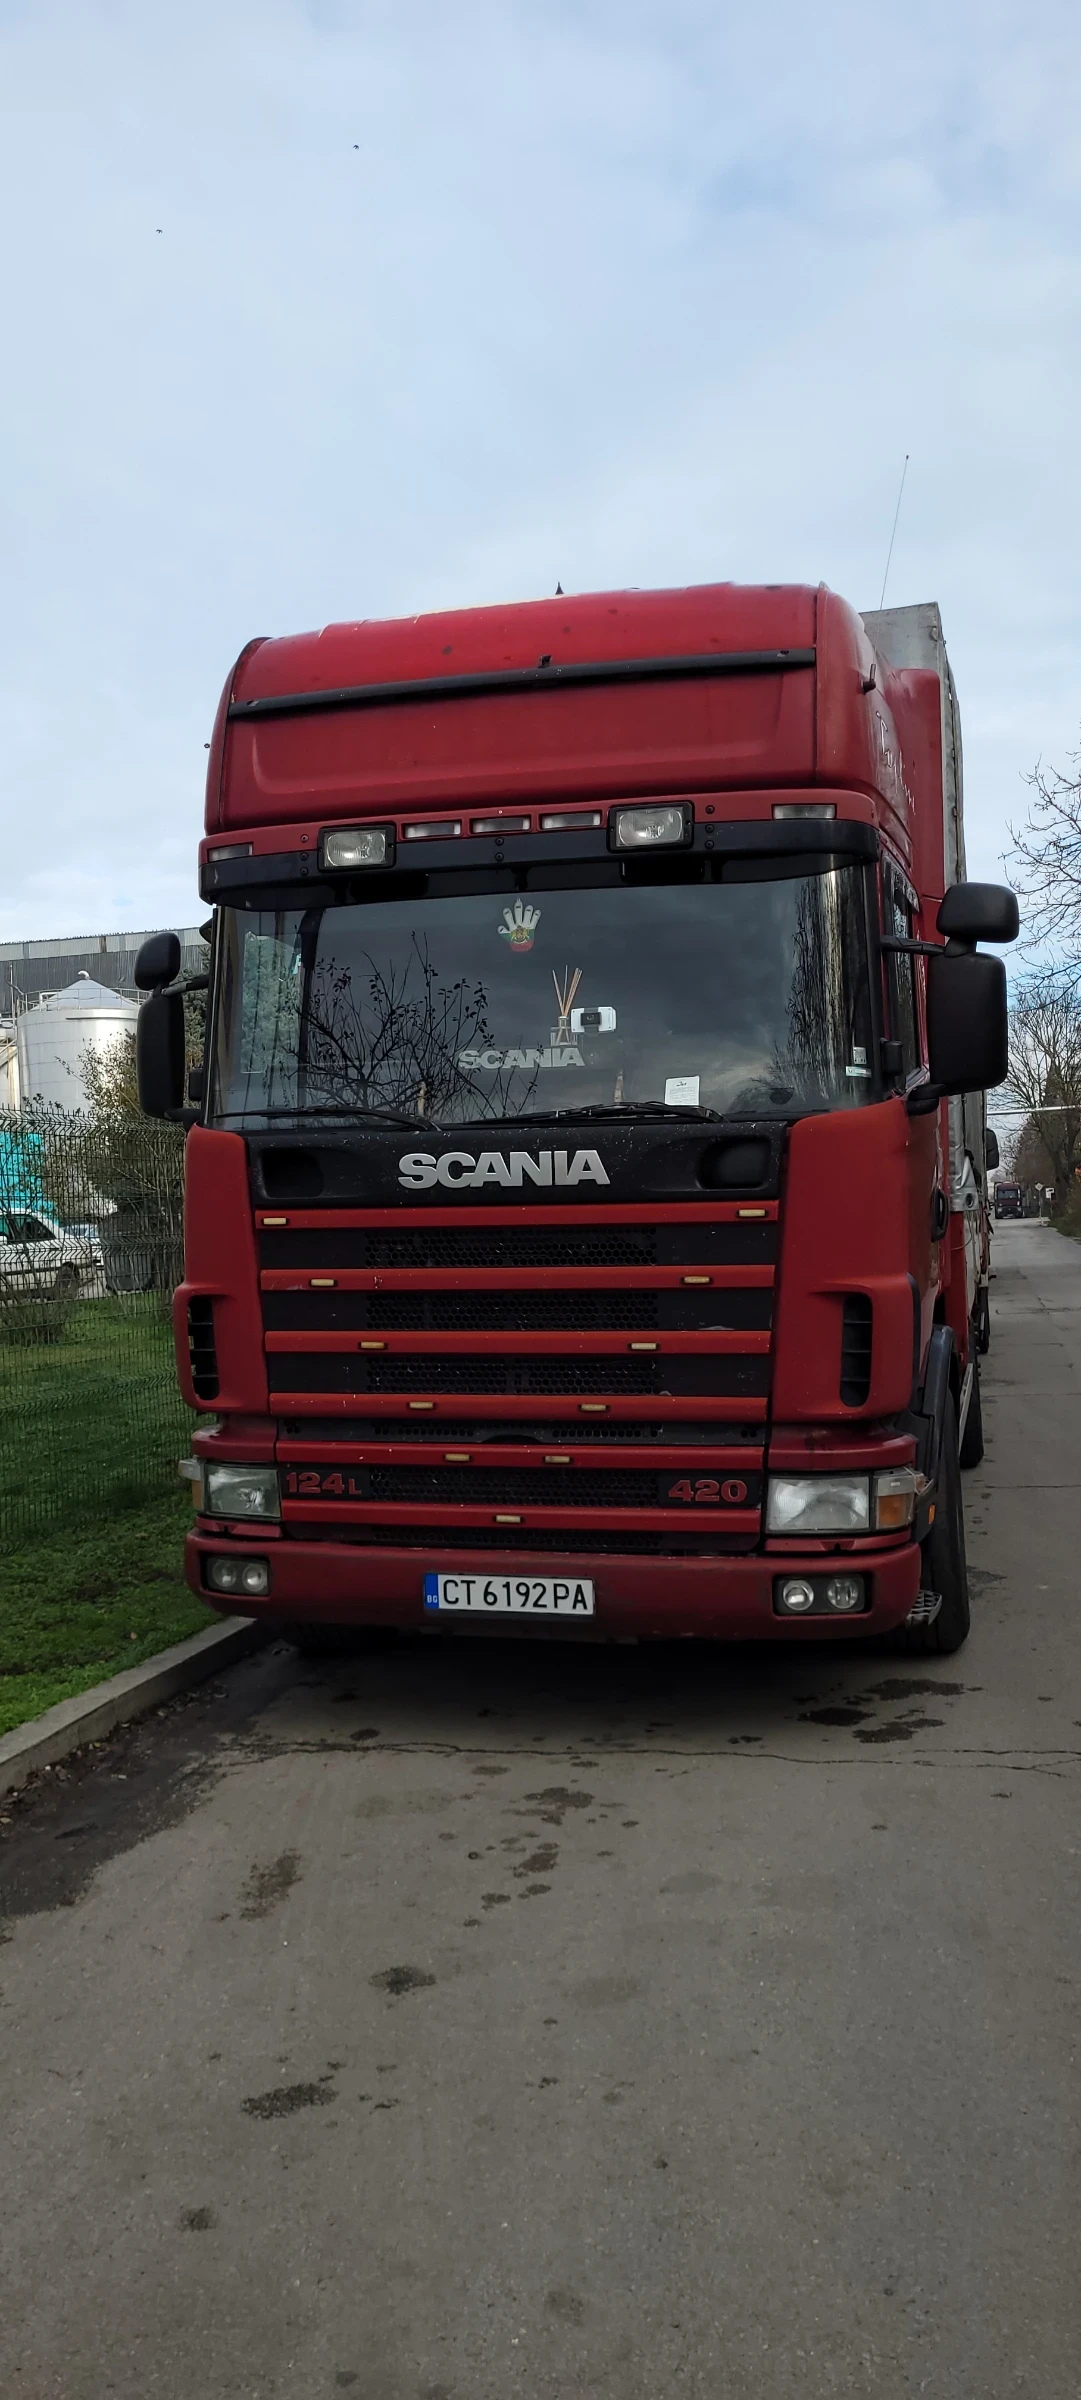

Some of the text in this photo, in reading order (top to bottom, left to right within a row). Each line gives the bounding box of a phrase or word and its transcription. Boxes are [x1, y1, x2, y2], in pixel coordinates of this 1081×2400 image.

[458, 1047, 586, 1069] SCANIA
[397, 1149, 611, 1189] SCANIA
[667, 1479, 748, 1503] 420
[426, 1594, 438, 1603] BG
[442, 1579, 588, 1610] CT 6192 PA
